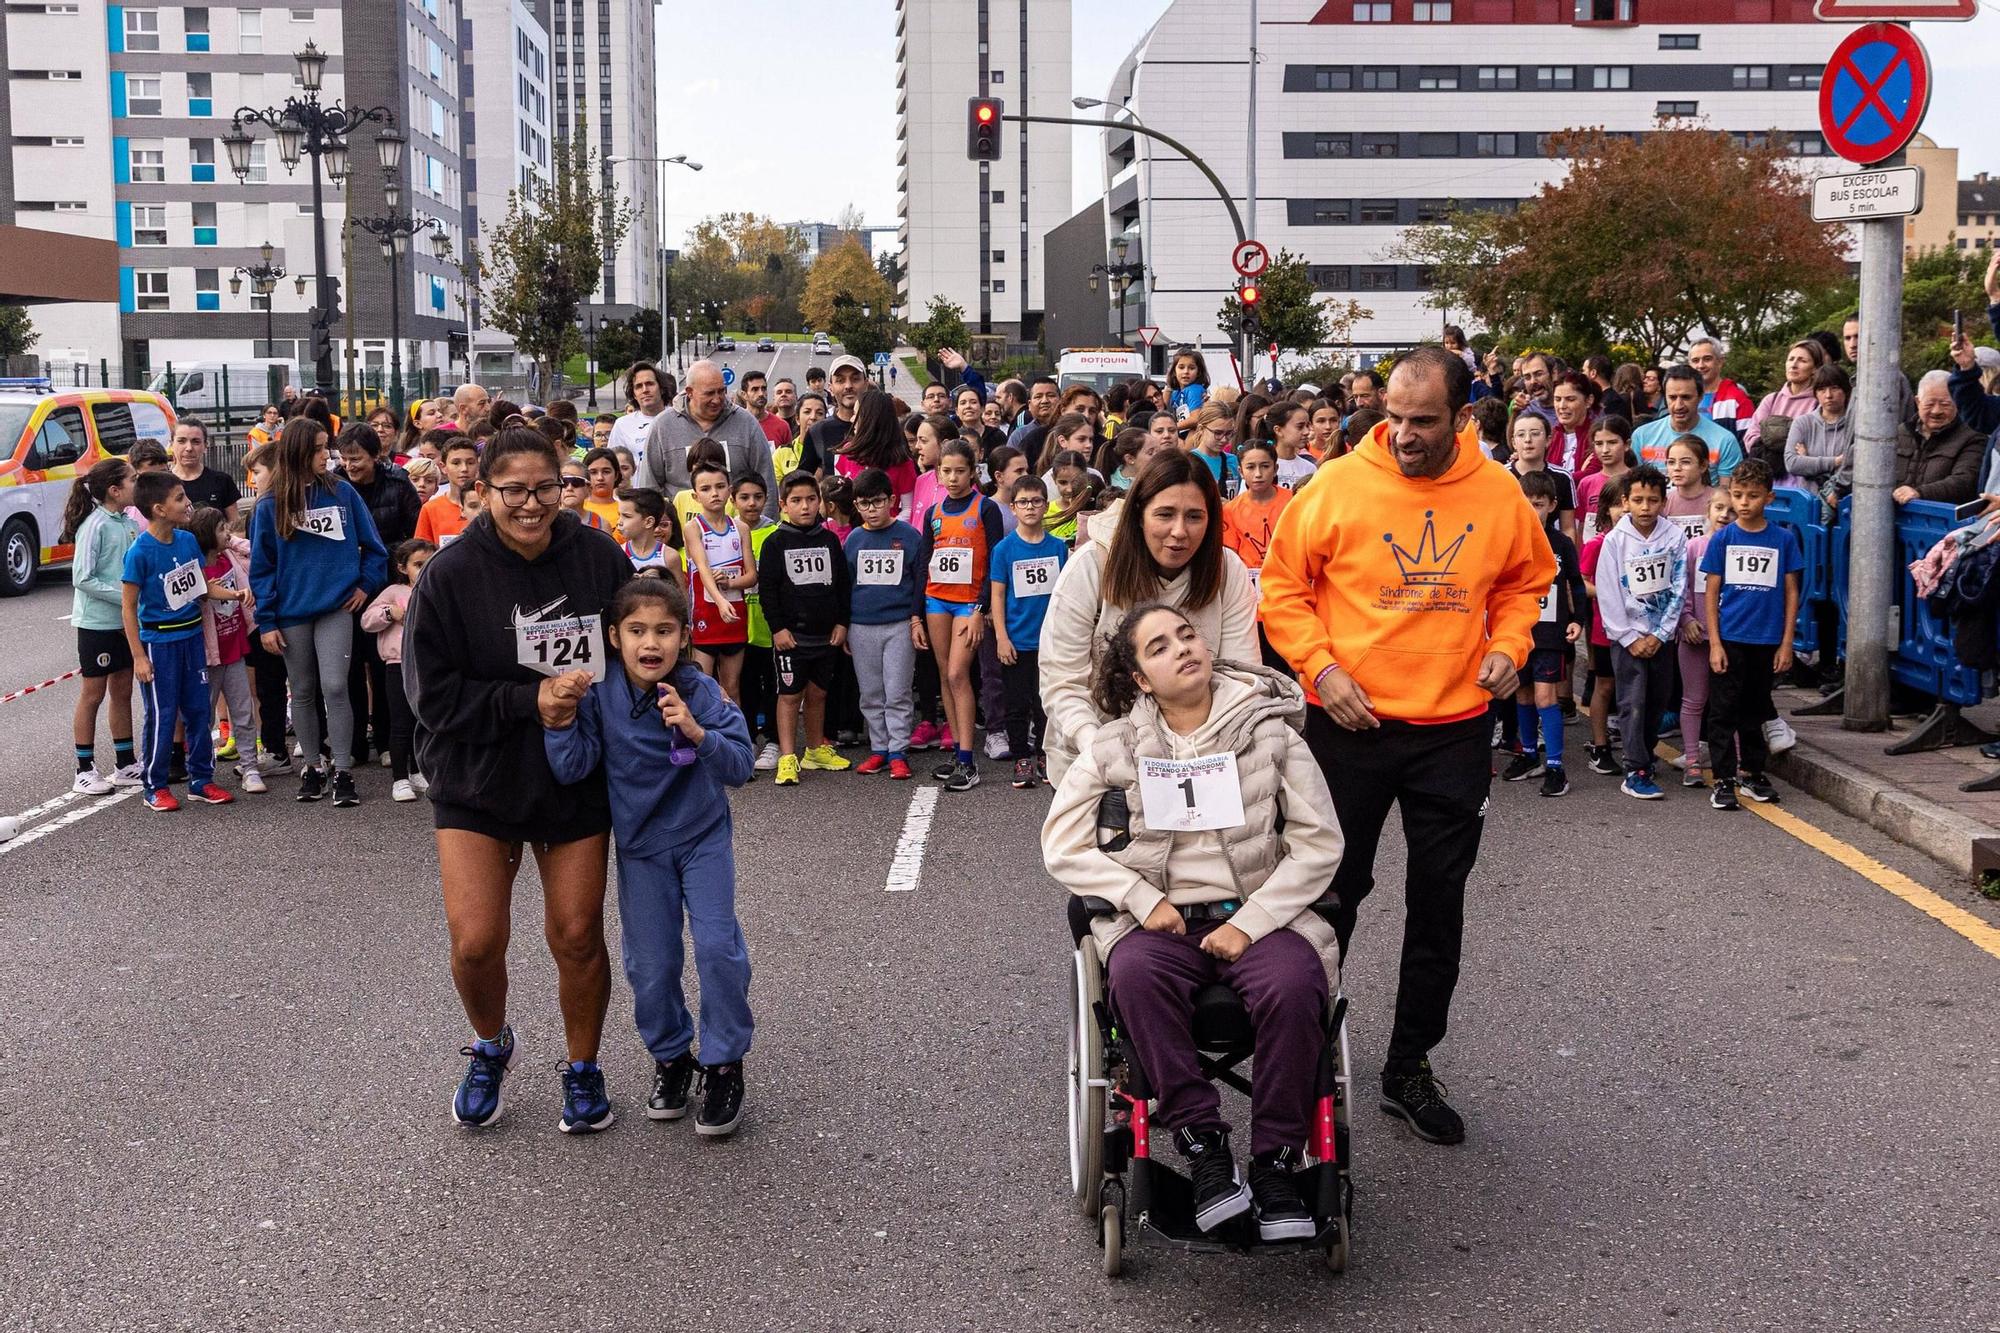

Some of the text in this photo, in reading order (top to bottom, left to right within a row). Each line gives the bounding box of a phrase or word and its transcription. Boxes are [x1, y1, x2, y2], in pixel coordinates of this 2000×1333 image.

[1843, 174, 1887, 187] EXCEPTO
[1830, 186, 1899, 202] BUS ESCOLAR
[1849, 203, 1856, 213] 5
[306, 517, 334, 534] 92
[793, 557, 825, 574] 310
[864, 559, 895, 574] 313
[939, 557, 960, 573] 86
[1635, 562, 1666, 582] 317
[1736, 556, 1771, 573] 197
[172, 571, 197, 596] 450
[1025, 568, 1048, 584] 58
[1430, 586, 1441, 599] de
[1445, 587, 1469, 600] Rett
[526, 627, 558, 636] RETTANDO
[559, 626, 566, 634] AL
[530, 624, 550, 632] DOBLE
[551, 622, 567, 630] MILLA
[555, 629, 594, 639] RETT
[533, 636, 592, 667] 124
[778, 655, 792, 671] 11
[1147, 766, 1180, 774] RETTANDO
[1192, 761, 1225, 771] SINDROME
[1151, 761, 1171, 769] DOBLE
[1192, 755, 1229, 767] SOLIDARIA
[1177, 767, 1227, 778] RETT
[1178, 778, 1195, 808] 1
